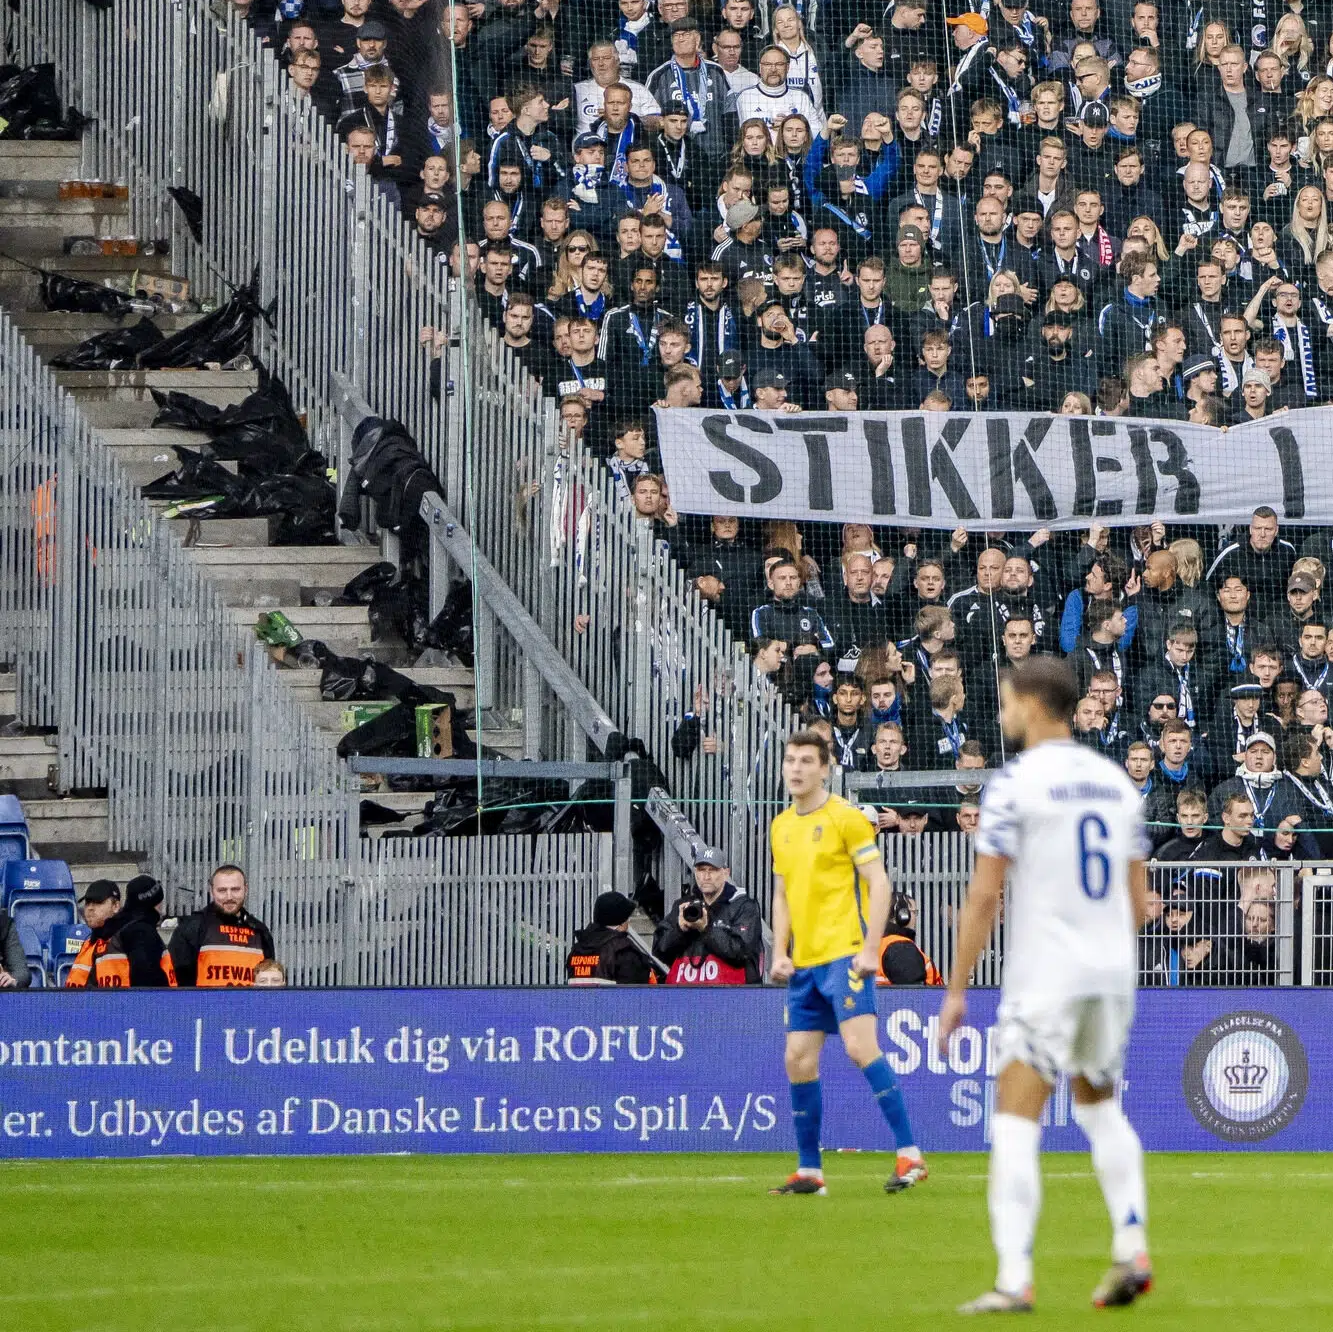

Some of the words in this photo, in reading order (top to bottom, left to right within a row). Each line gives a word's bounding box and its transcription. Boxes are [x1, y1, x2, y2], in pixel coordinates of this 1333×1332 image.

[701, 413, 1201, 520] STIKKER
[1268, 426, 1306, 519] I
[1075, 813, 1112, 900] 6
[205, 964, 255, 982] STEWA
[571, 955, 600, 966] RESPONSE
[575, 966, 592, 976] TEAM
[676, 961, 719, 984] FOTO
[223, 1026, 375, 1066] Udeluk
[384, 1025, 451, 1073] dig
[460, 1028, 521, 1063] via
[532, 1025, 685, 1063] ROFUS
[66, 1098, 244, 1147] Udbydes
[256, 1097, 299, 1135] af
[307, 1096, 461, 1135] Danske
[472, 1095, 602, 1133] Licens
[612, 1095, 689, 1144] Spil
[698, 1092, 777, 1142] A/S
